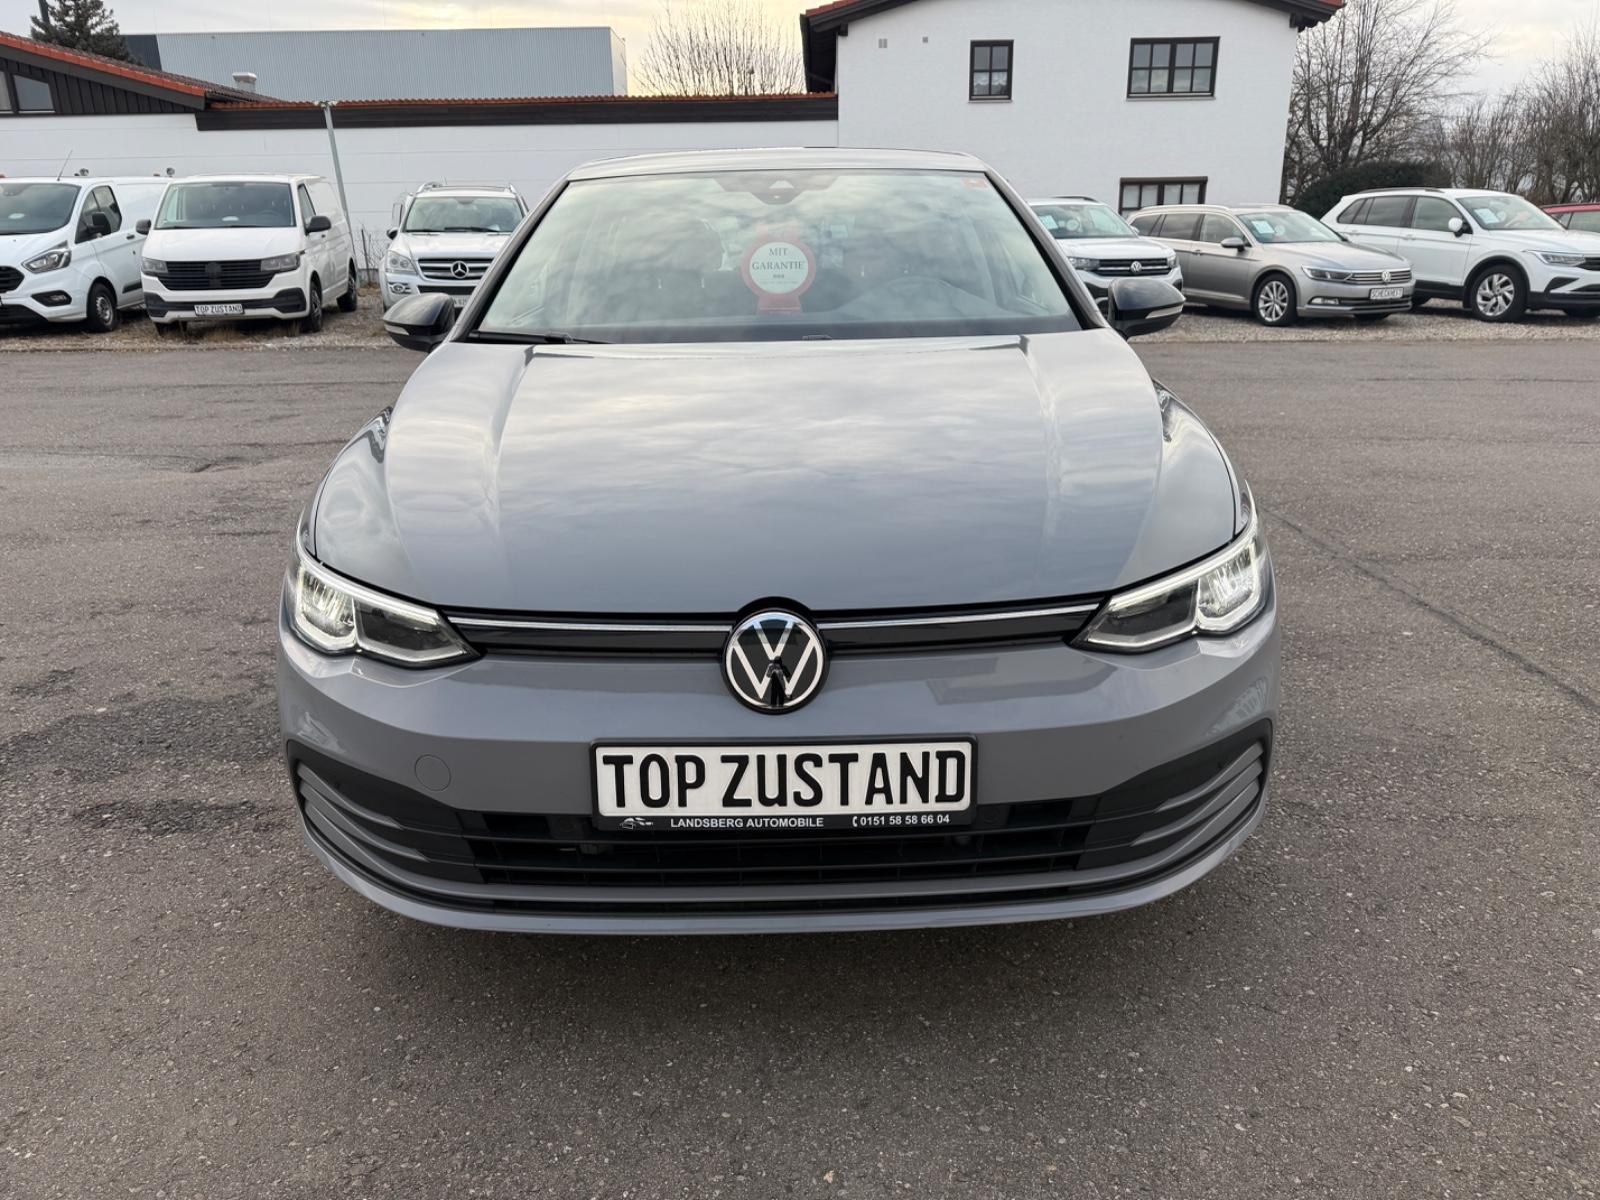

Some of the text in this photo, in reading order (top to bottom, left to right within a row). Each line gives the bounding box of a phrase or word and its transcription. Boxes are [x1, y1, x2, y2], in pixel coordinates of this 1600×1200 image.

[768, 247, 788, 257] MIT
[752, 261, 803, 270] GARANTIE
[211, 304, 242, 313] ZUSTAND
[602, 750, 966, 808] TOP ZUSTAND
[670, 817, 824, 828] LANDSBERG AUTOMOBILE
[860, 814, 950, 826] 0151 58 58 66 04
